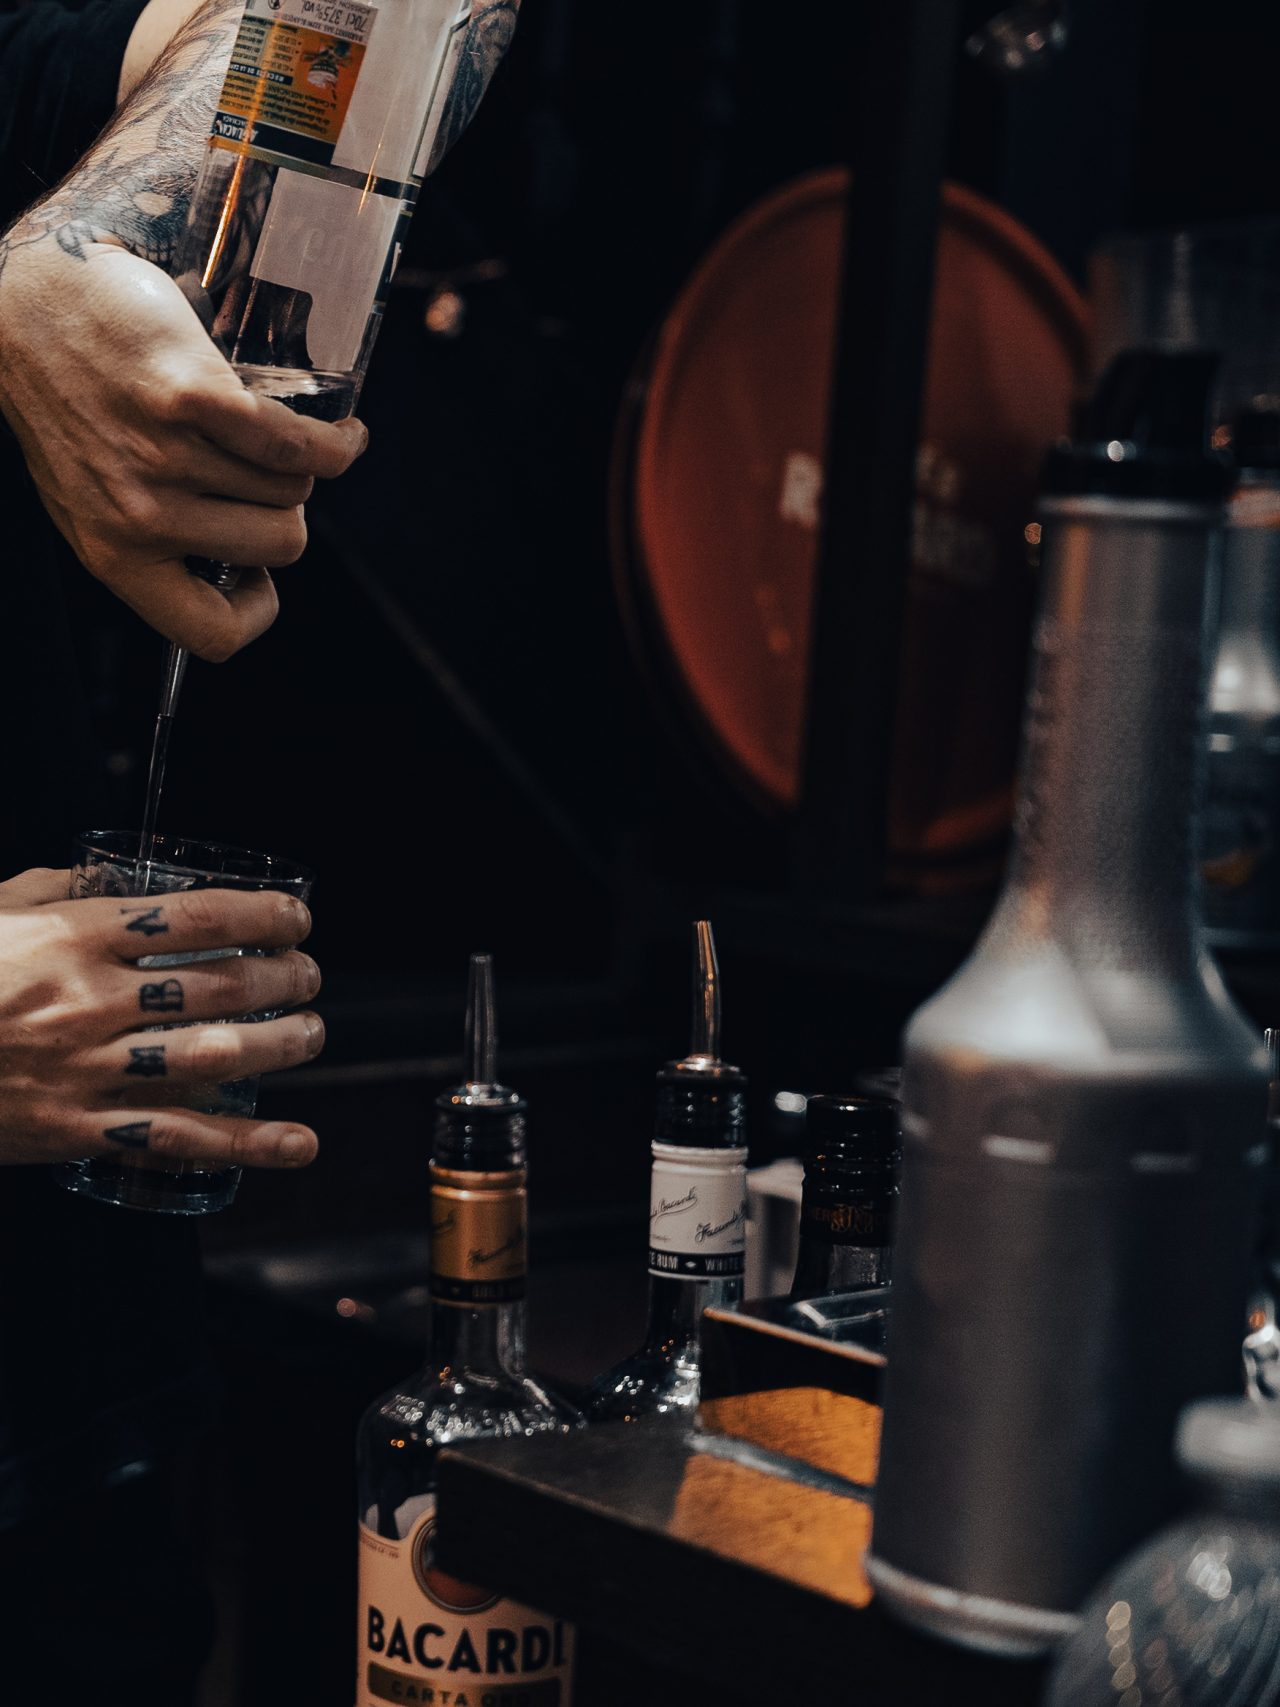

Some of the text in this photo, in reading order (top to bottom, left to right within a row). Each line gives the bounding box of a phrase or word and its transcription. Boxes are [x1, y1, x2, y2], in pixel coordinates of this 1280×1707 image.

[656, 1254, 679, 1270] RUM
[368, 1604, 565, 1675] BACARDI
[391, 1679, 468, 1706] CARTA
